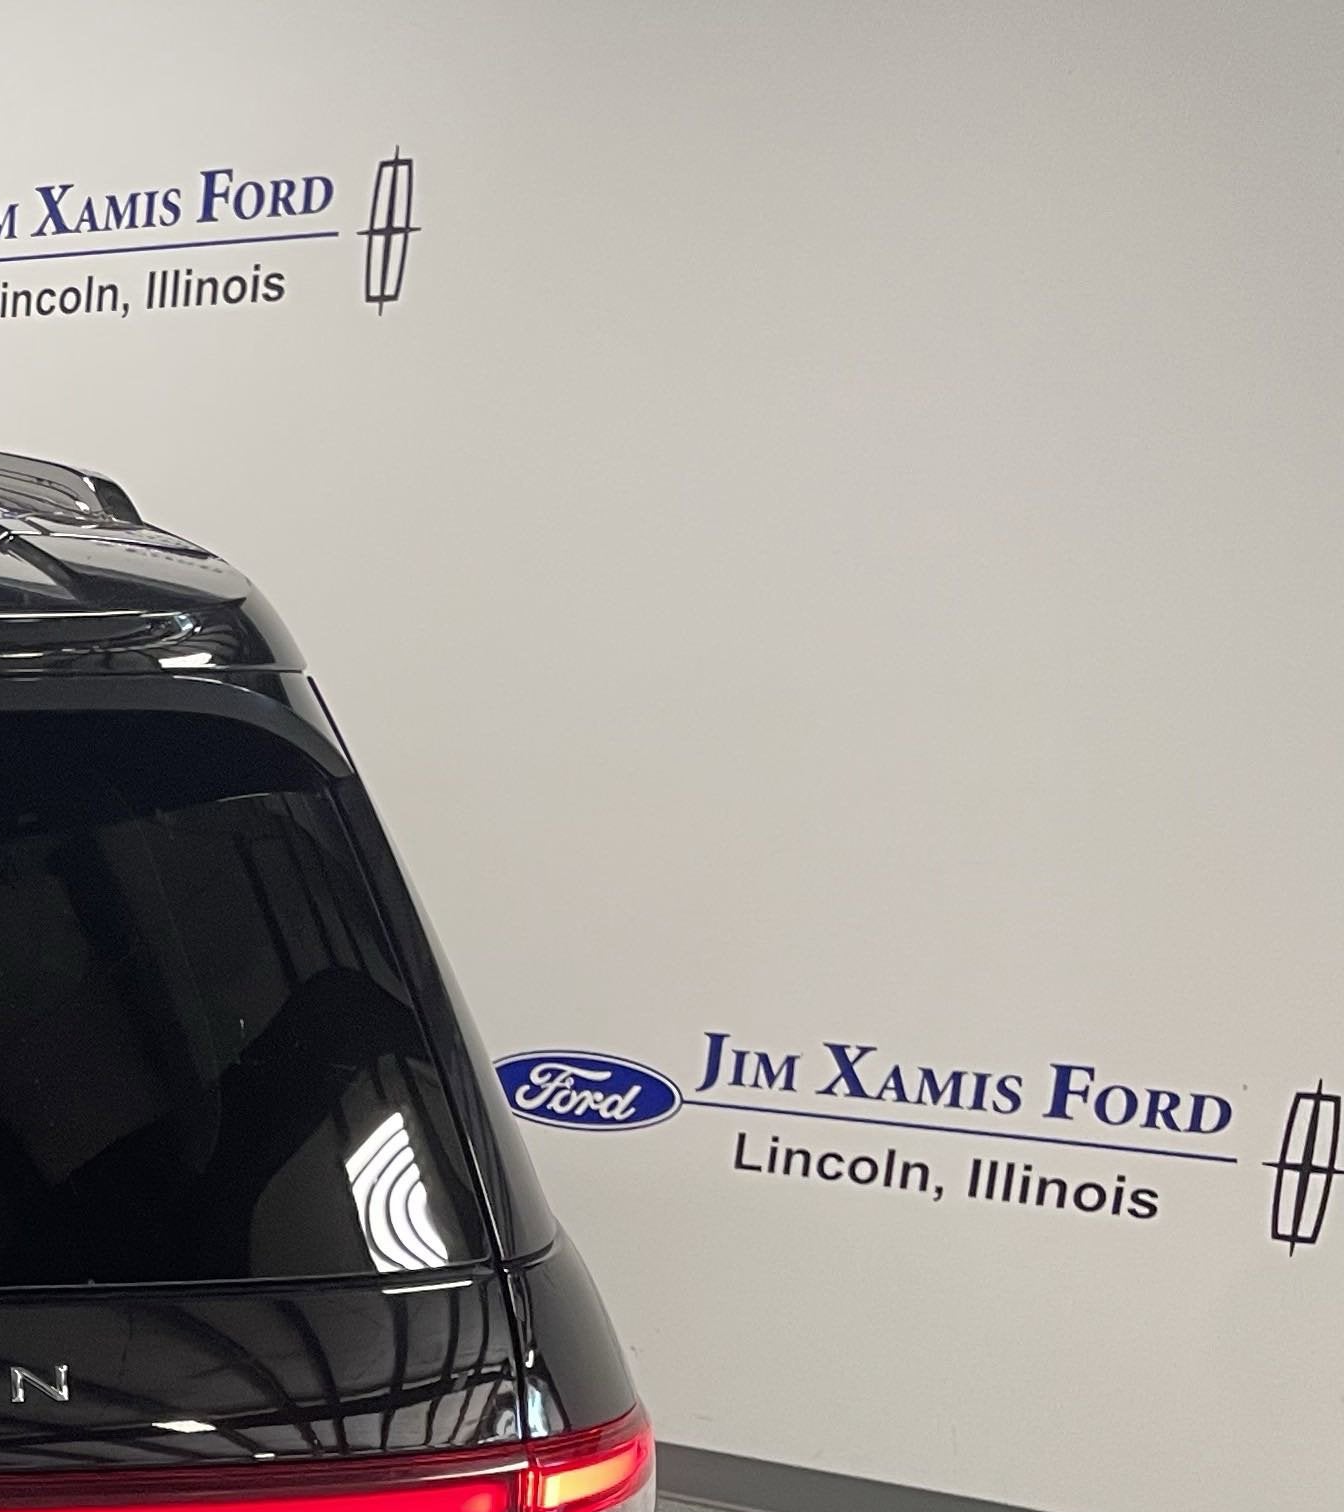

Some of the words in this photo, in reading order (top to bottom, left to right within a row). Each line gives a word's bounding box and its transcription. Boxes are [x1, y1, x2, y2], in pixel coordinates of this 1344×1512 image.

[30, 184, 181, 237] XAMIS
[196, 168, 333, 223] FORD
[146, 263, 286, 310] Illinois
[695, 1031, 799, 1092] JIM
[814, 1042, 1023, 1115] XAMIS
[1041, 1062, 1233, 1135] FORD
[733, 1131, 945, 1202] Lincoln,
[967, 1156, 1162, 1220] Illinois
